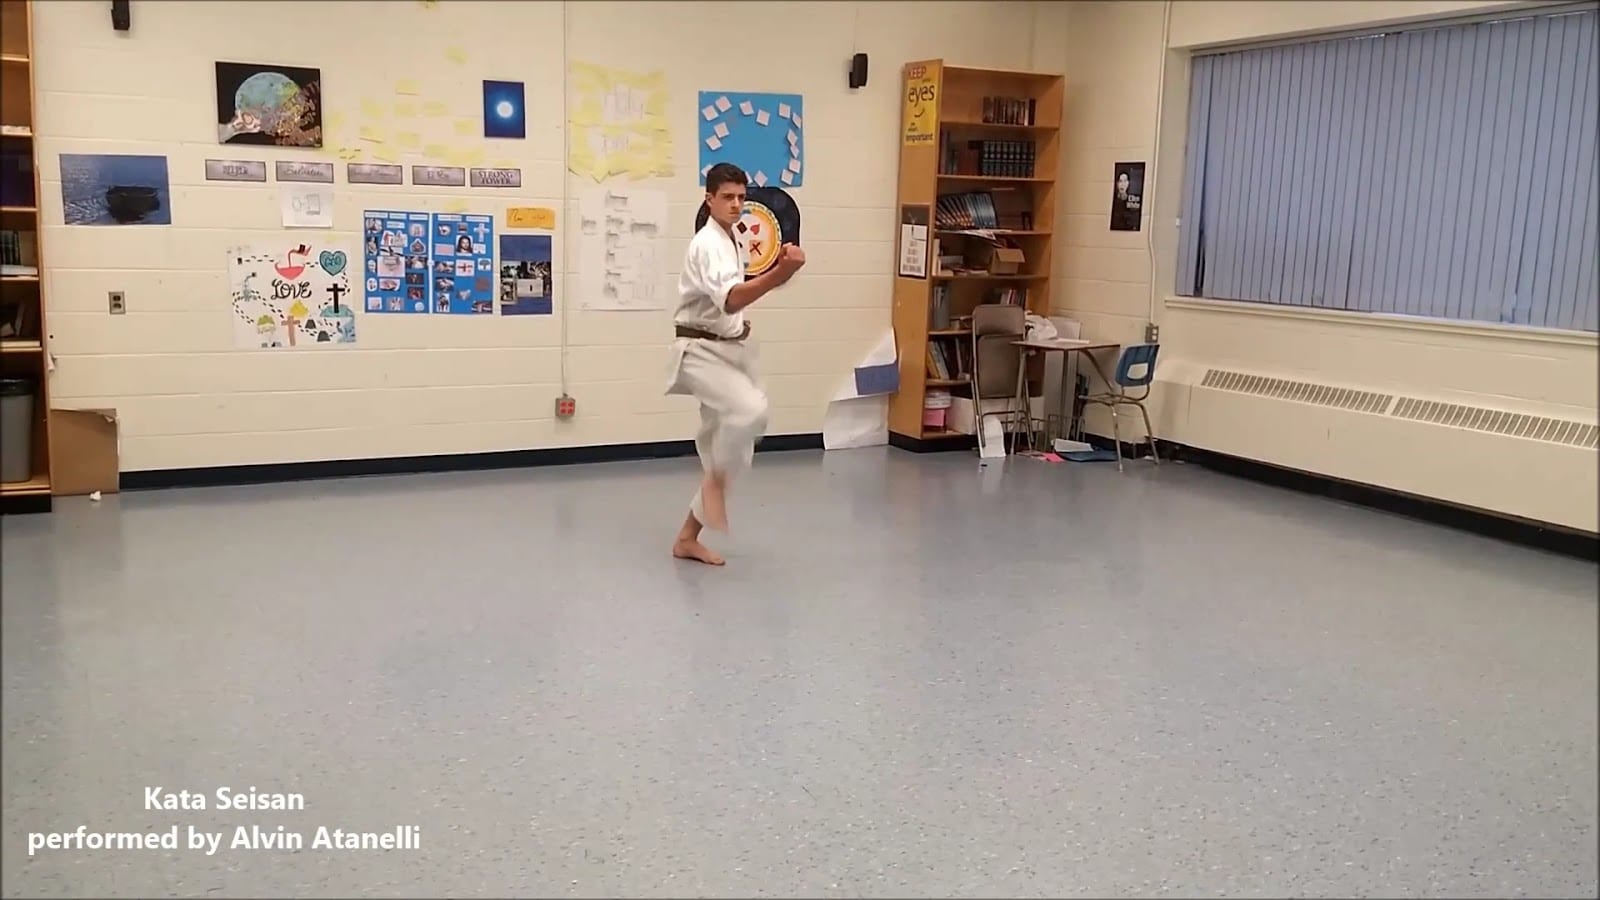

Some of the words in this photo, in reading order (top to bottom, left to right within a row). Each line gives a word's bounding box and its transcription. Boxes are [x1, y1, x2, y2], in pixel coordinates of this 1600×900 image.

[908, 85, 935, 108] eyes
[906, 133, 933, 143] important
[477, 170, 514, 179] STRONG
[480, 177, 513, 185] TOWER
[270, 278, 313, 300] LOVE
